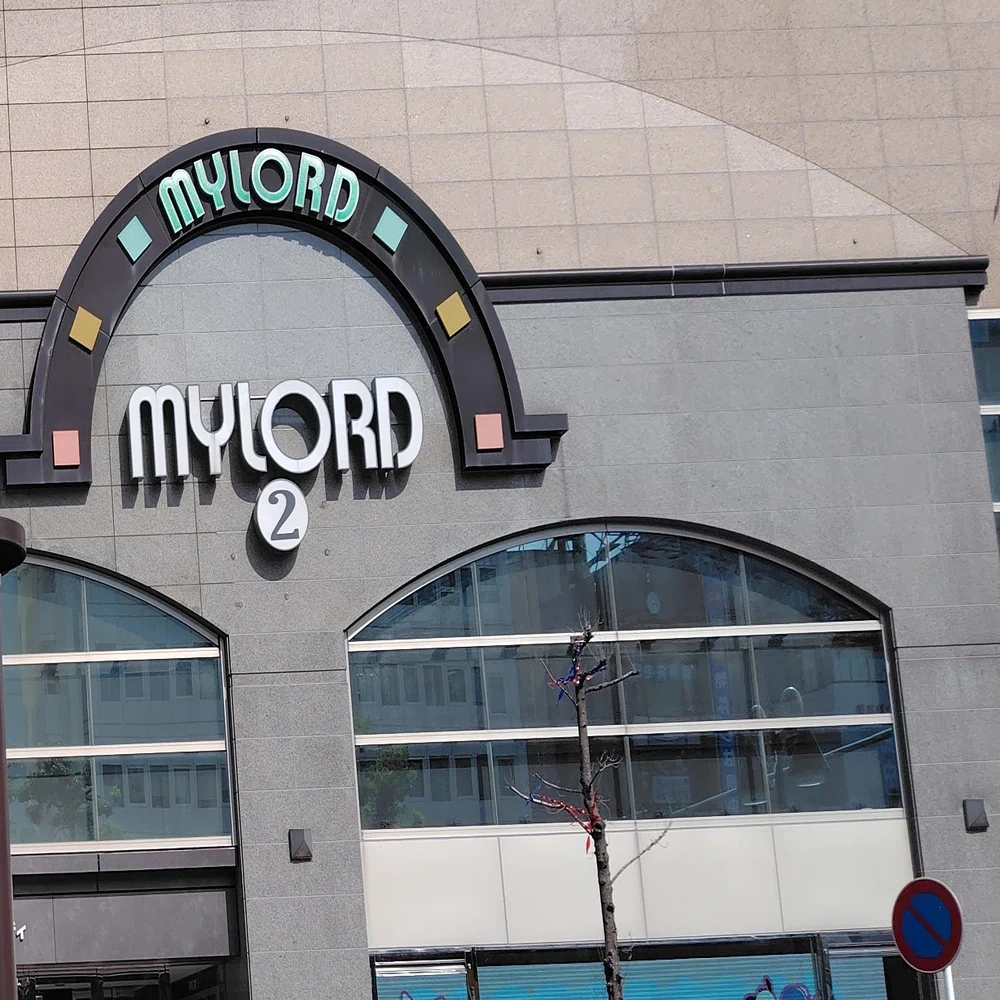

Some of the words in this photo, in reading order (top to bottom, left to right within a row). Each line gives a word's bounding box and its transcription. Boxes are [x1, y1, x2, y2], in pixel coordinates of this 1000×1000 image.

[158, 147, 360, 234] MYLORD
[127, 376, 423, 481] MYLORD
[269, 489, 301, 542] 2
